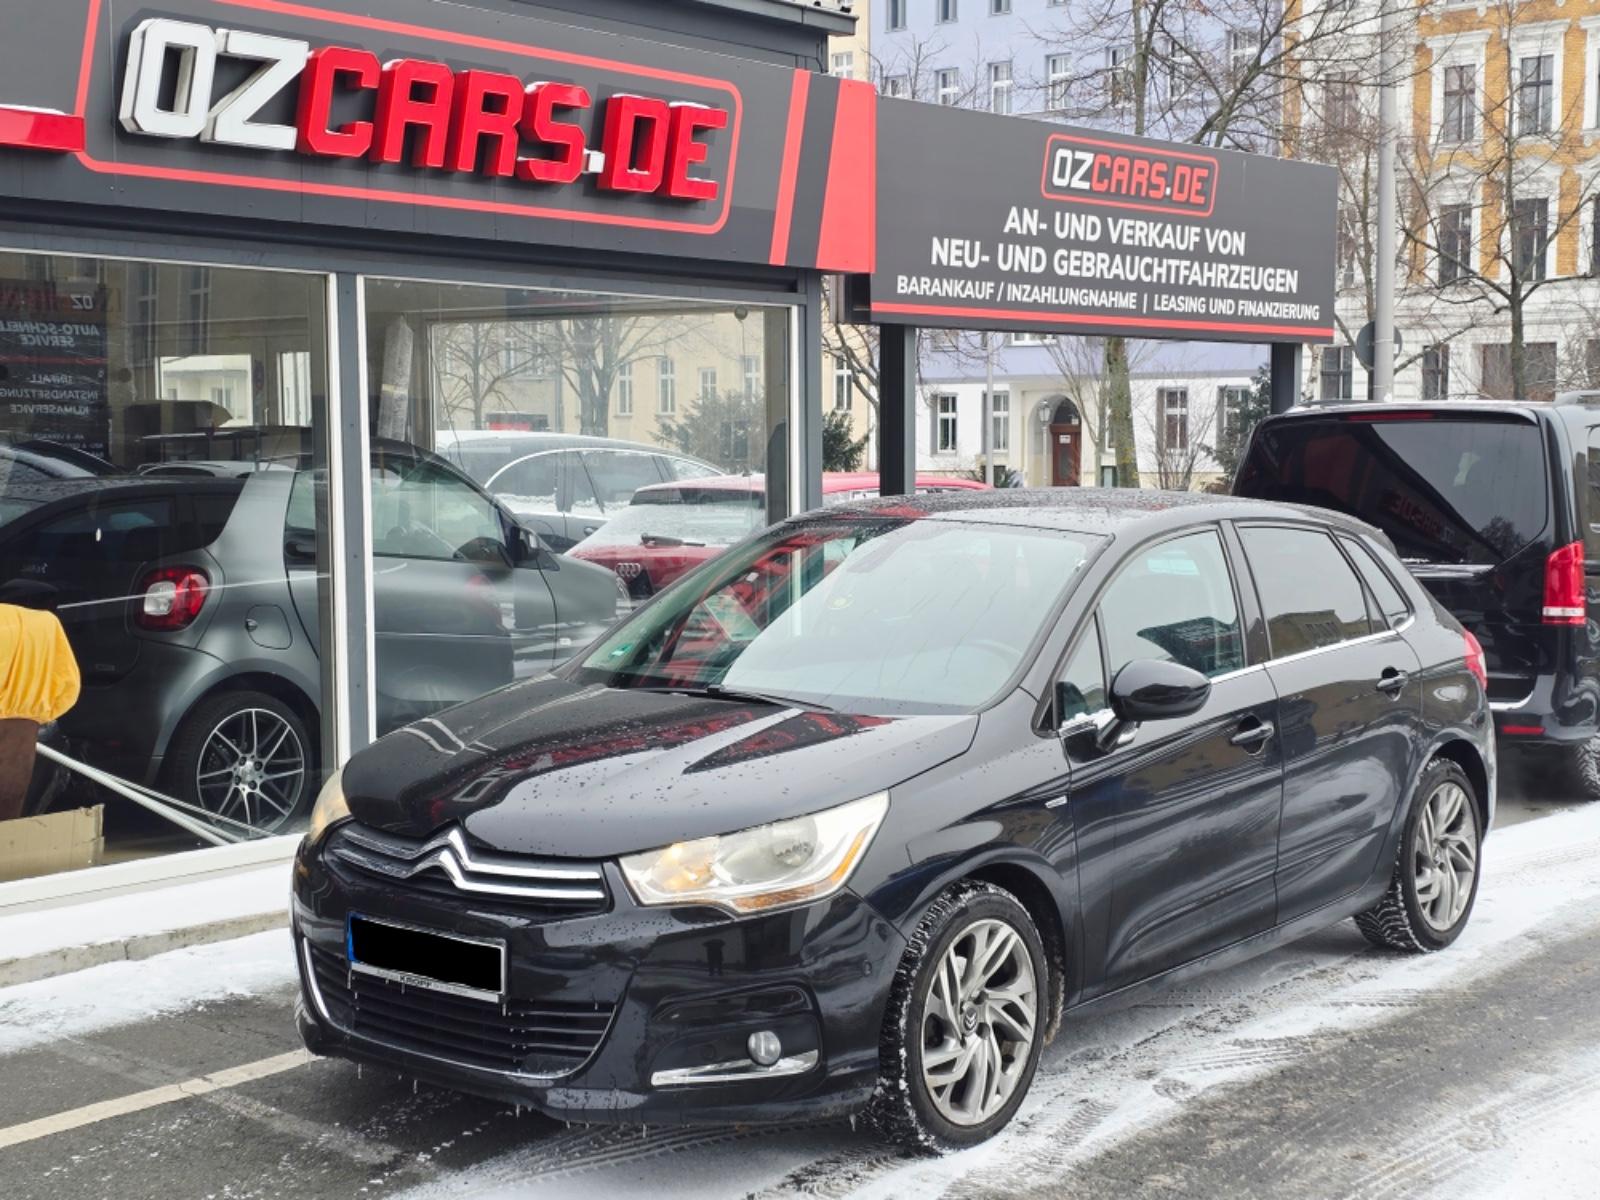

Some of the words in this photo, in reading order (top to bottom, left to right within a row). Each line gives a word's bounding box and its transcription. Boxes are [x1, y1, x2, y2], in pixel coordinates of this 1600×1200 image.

[119, 18, 728, 201] OZCARS.DE
[1052, 148, 1209, 205] OZCARS.DE
[1003, 206, 1048, 236] AN-
[1054, 211, 1101, 242] UND
[1107, 217, 1201, 251] VERKAUF
[1205, 228, 1246, 256] VON
[930, 236, 990, 268] NEU-
[997, 243, 1047, 274] UND
[1053, 248, 1299, 294] GEBRAUCHTFAHRZEUGEN
[896, 274, 995, 300] BARANKAUF
[1006, 283, 1137, 310] INZAHLUNGNAHME
[1153, 293, 1206, 315] LEASING
[1209, 297, 1235, 316] UND
[1237, 299, 1320, 321] FINANZIERUNG
